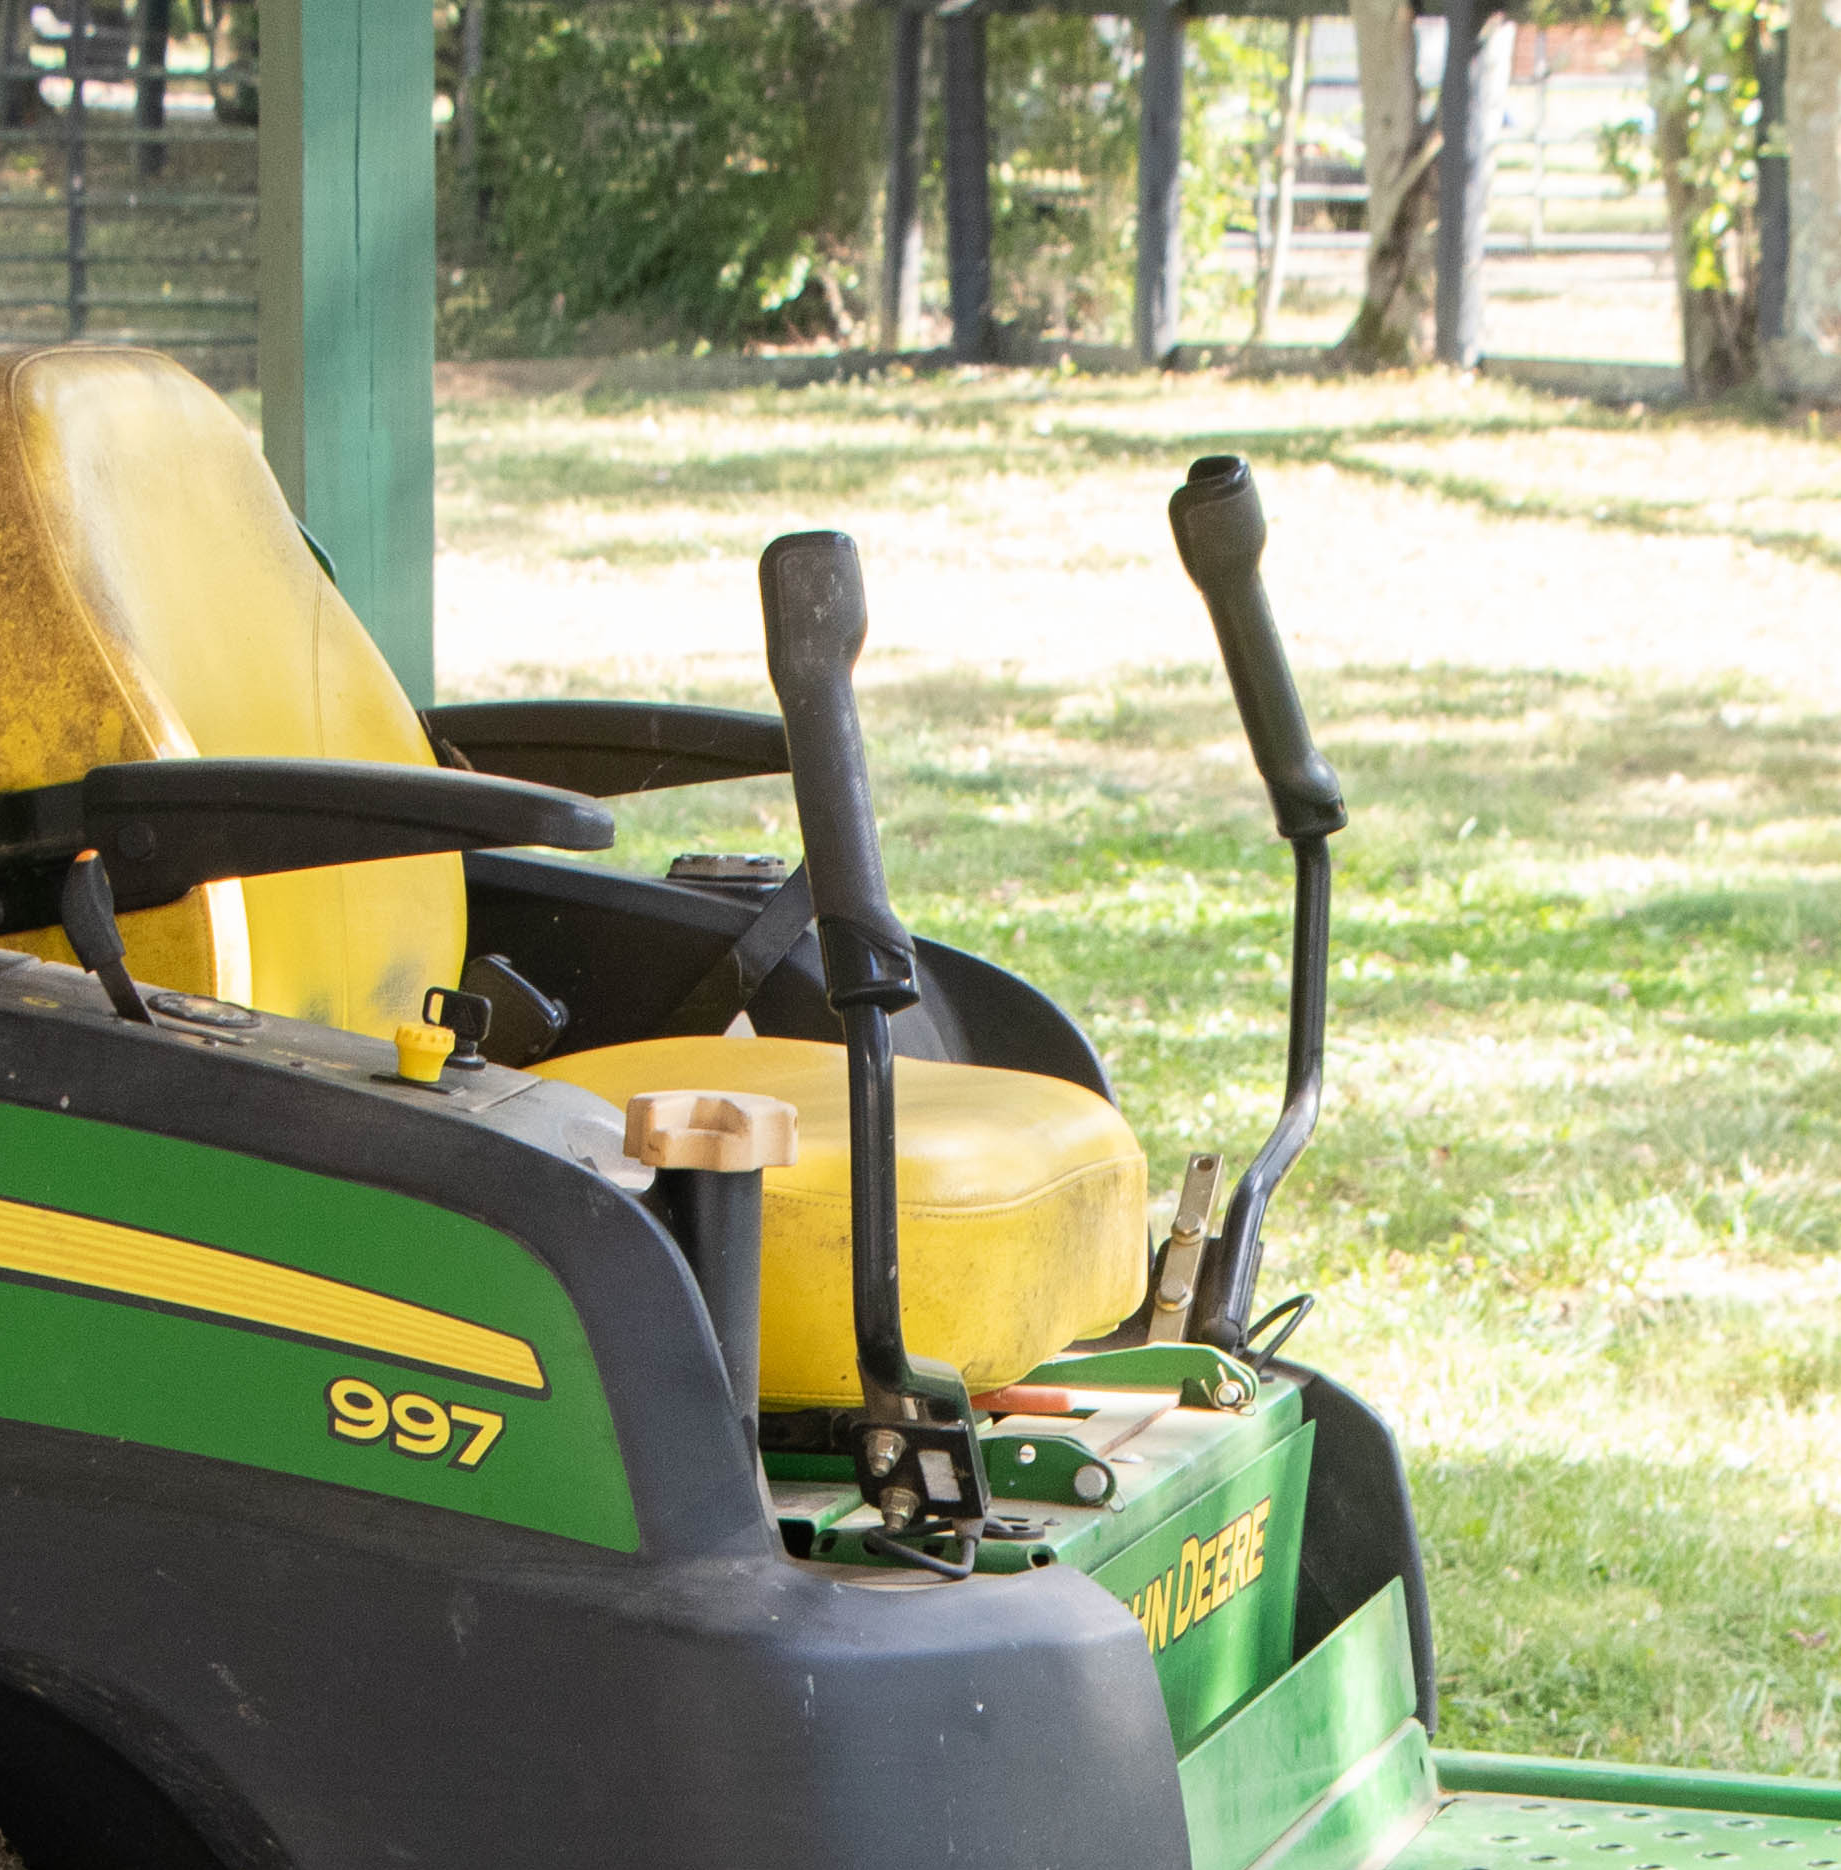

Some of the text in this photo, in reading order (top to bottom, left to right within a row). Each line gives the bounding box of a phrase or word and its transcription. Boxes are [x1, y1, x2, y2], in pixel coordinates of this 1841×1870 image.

[326, 1376, 506, 1471] 997
[1123, 1496, 1271, 1654] HN DEERE
